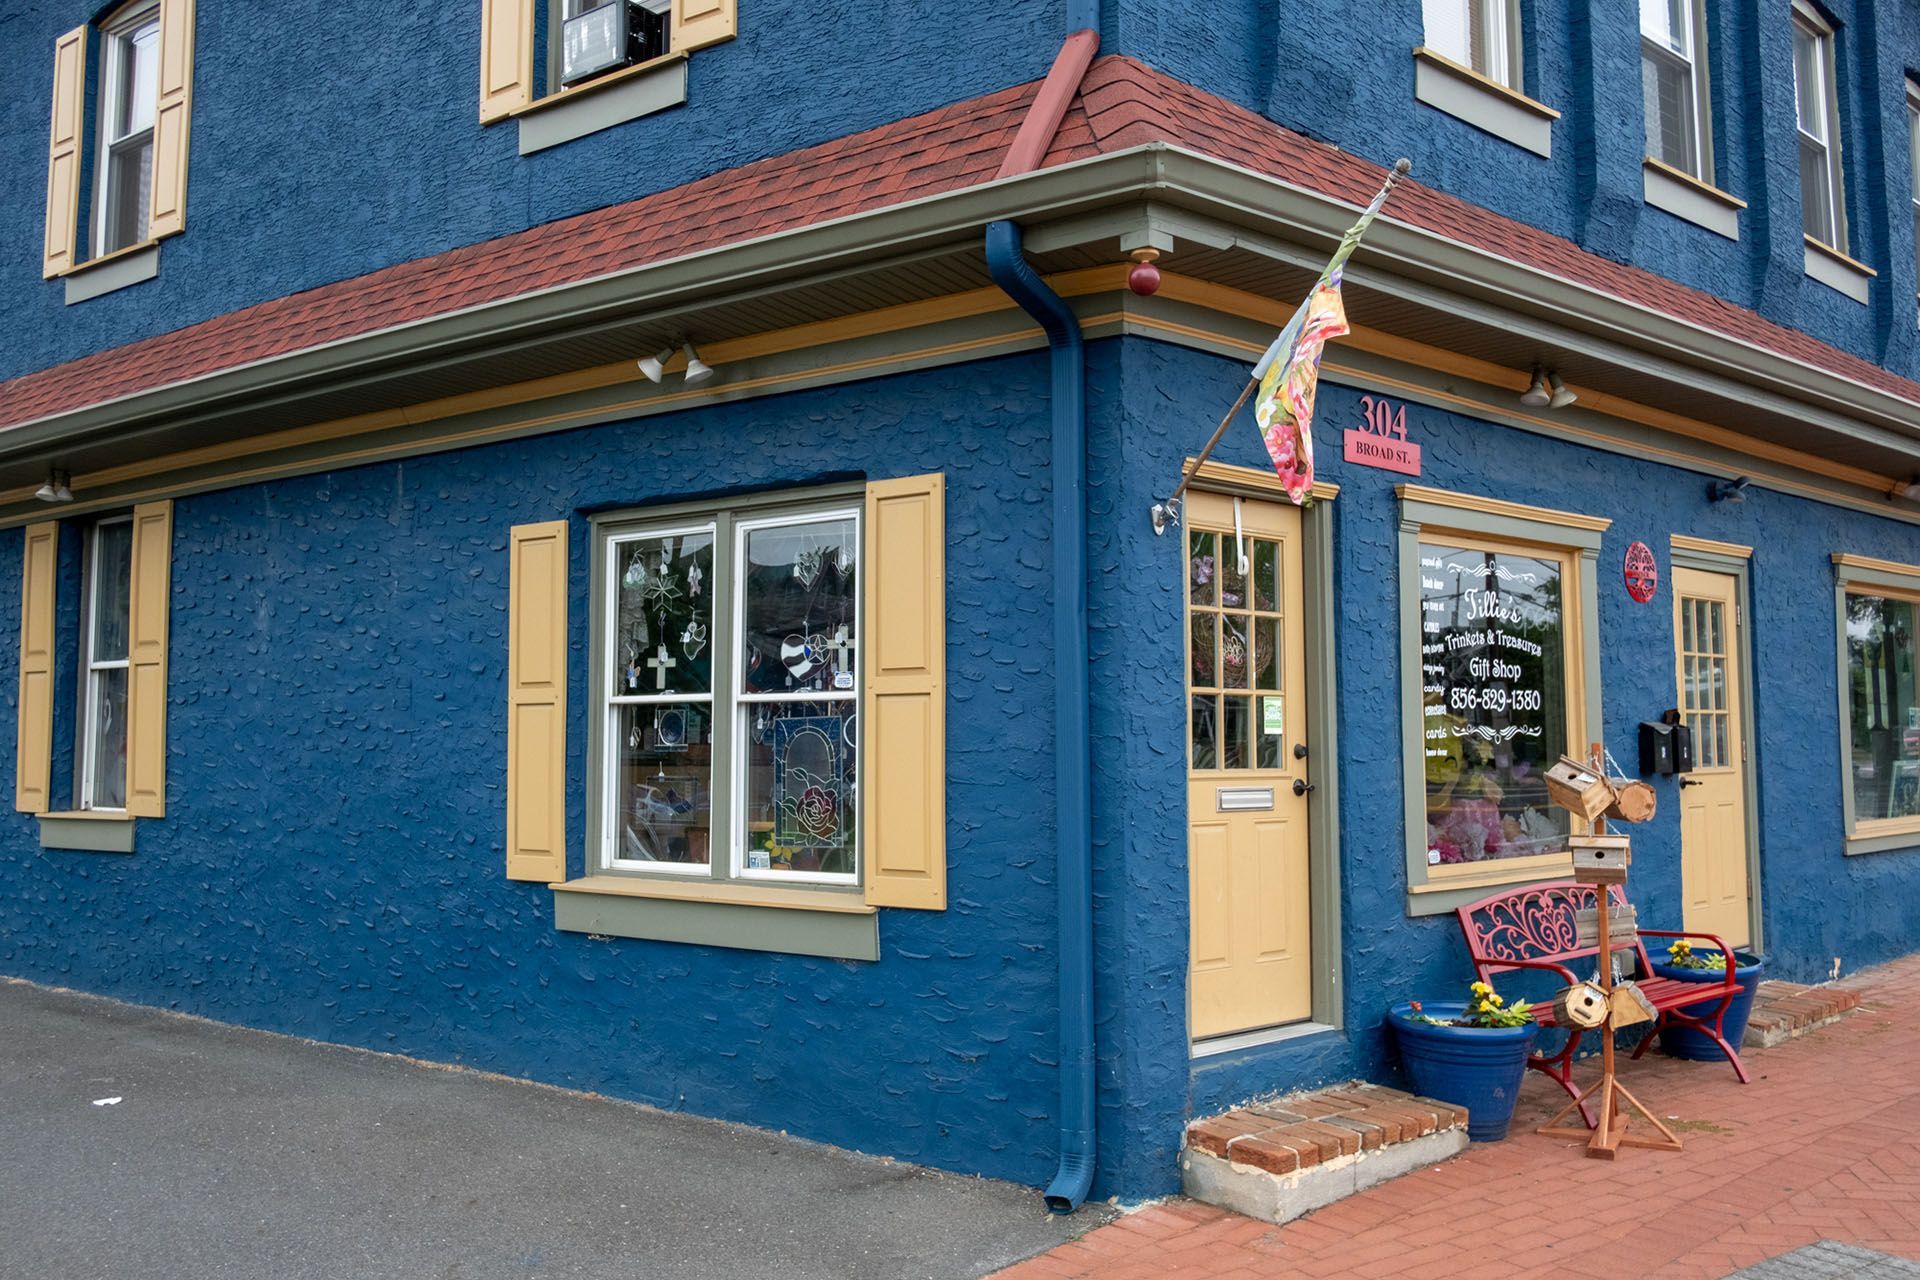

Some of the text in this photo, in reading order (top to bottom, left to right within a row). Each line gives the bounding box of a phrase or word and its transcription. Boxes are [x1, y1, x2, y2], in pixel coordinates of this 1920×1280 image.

[1358, 394, 1408, 442] 304
[1356, 441, 1411, 464] BROAD ST.
[1464, 587, 1521, 623] Tillie's
[1445, 631, 1485, 651] Trinkets
[1487, 628, 1496, 645] &
[1496, 629, 1542, 657] Treasures
[1469, 656, 1490, 681] Gift
[1492, 658, 1522, 683] Shop
[1450, 687, 1541, 712] 856-829-1380
[1426, 725, 1448, 740] cards
